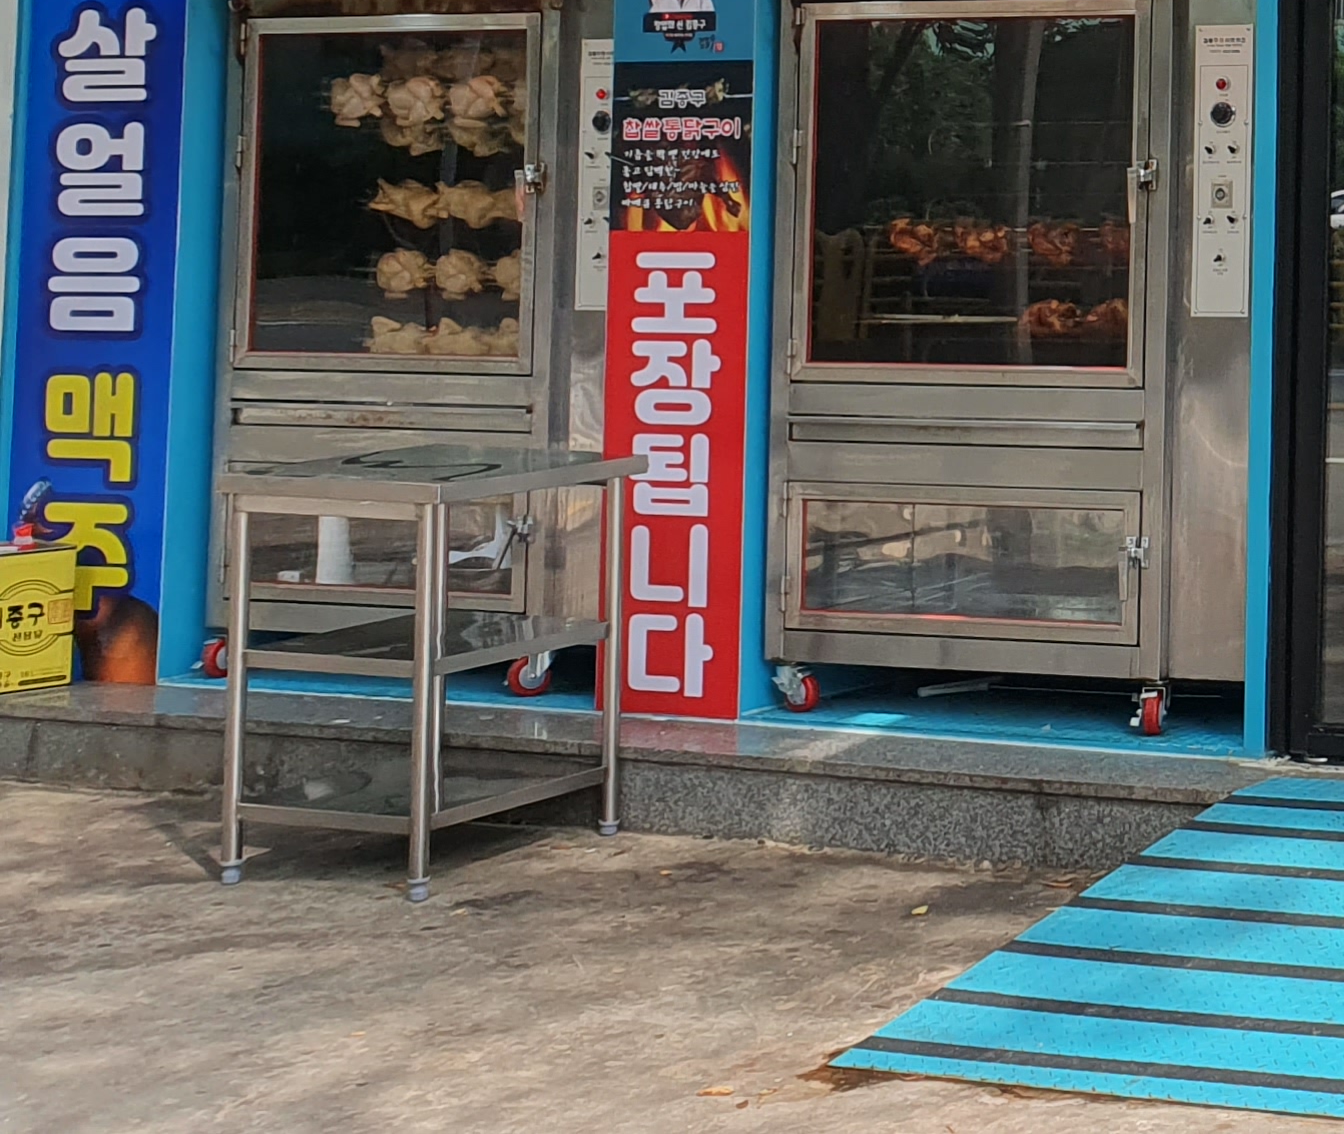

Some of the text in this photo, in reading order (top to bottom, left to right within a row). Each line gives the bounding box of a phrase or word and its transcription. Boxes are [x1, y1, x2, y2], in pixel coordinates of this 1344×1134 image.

[622, 116, 742, 141] 찹쌀통닭구이
[658, 88, 707, 109] 김종구
[48, 6, 157, 333] 살얼음
[44, 371, 136, 612] 맥주
[627, 250, 722, 699] 포장됩니다
[0, 602, 46, 630] 종구
